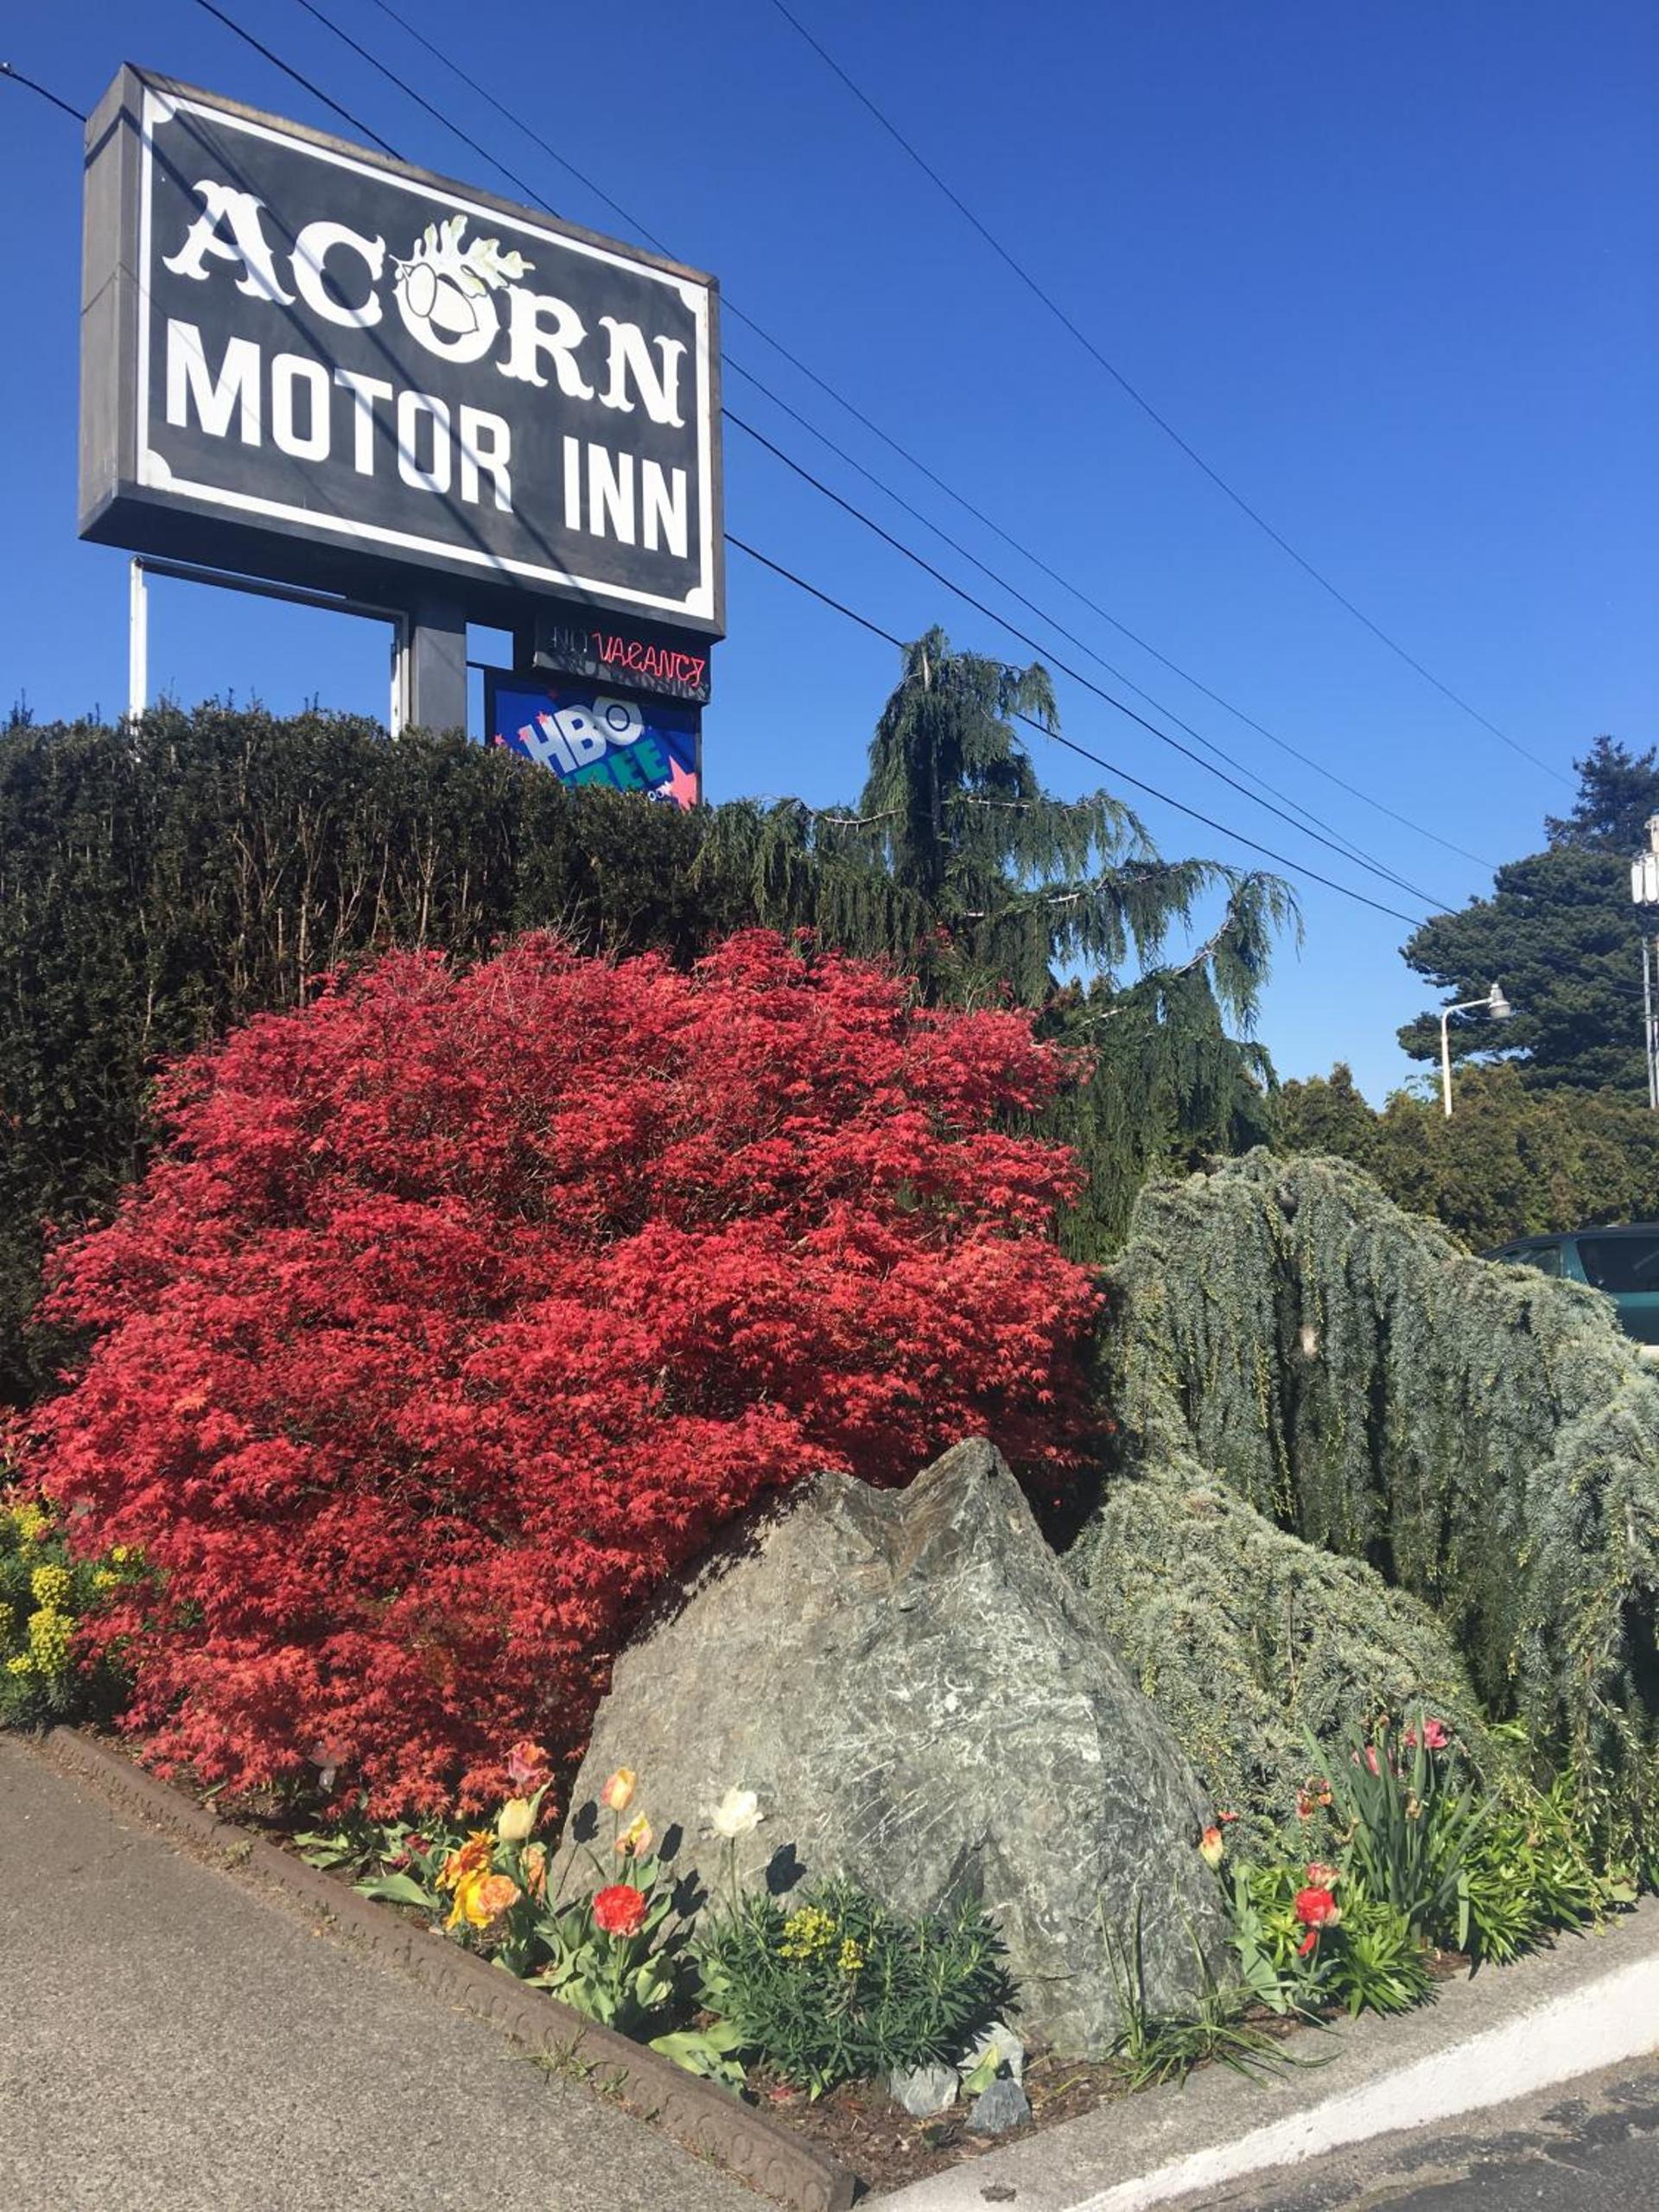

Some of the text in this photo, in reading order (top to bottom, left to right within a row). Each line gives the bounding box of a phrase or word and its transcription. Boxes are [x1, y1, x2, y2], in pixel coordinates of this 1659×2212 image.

[162, 179, 688, 429] ACORN
[166, 317, 689, 560] MOTOR INN
[591, 632, 706, 688] VACANCY
[518, 695, 645, 775] HBO
[561, 737, 670, 793] EE
